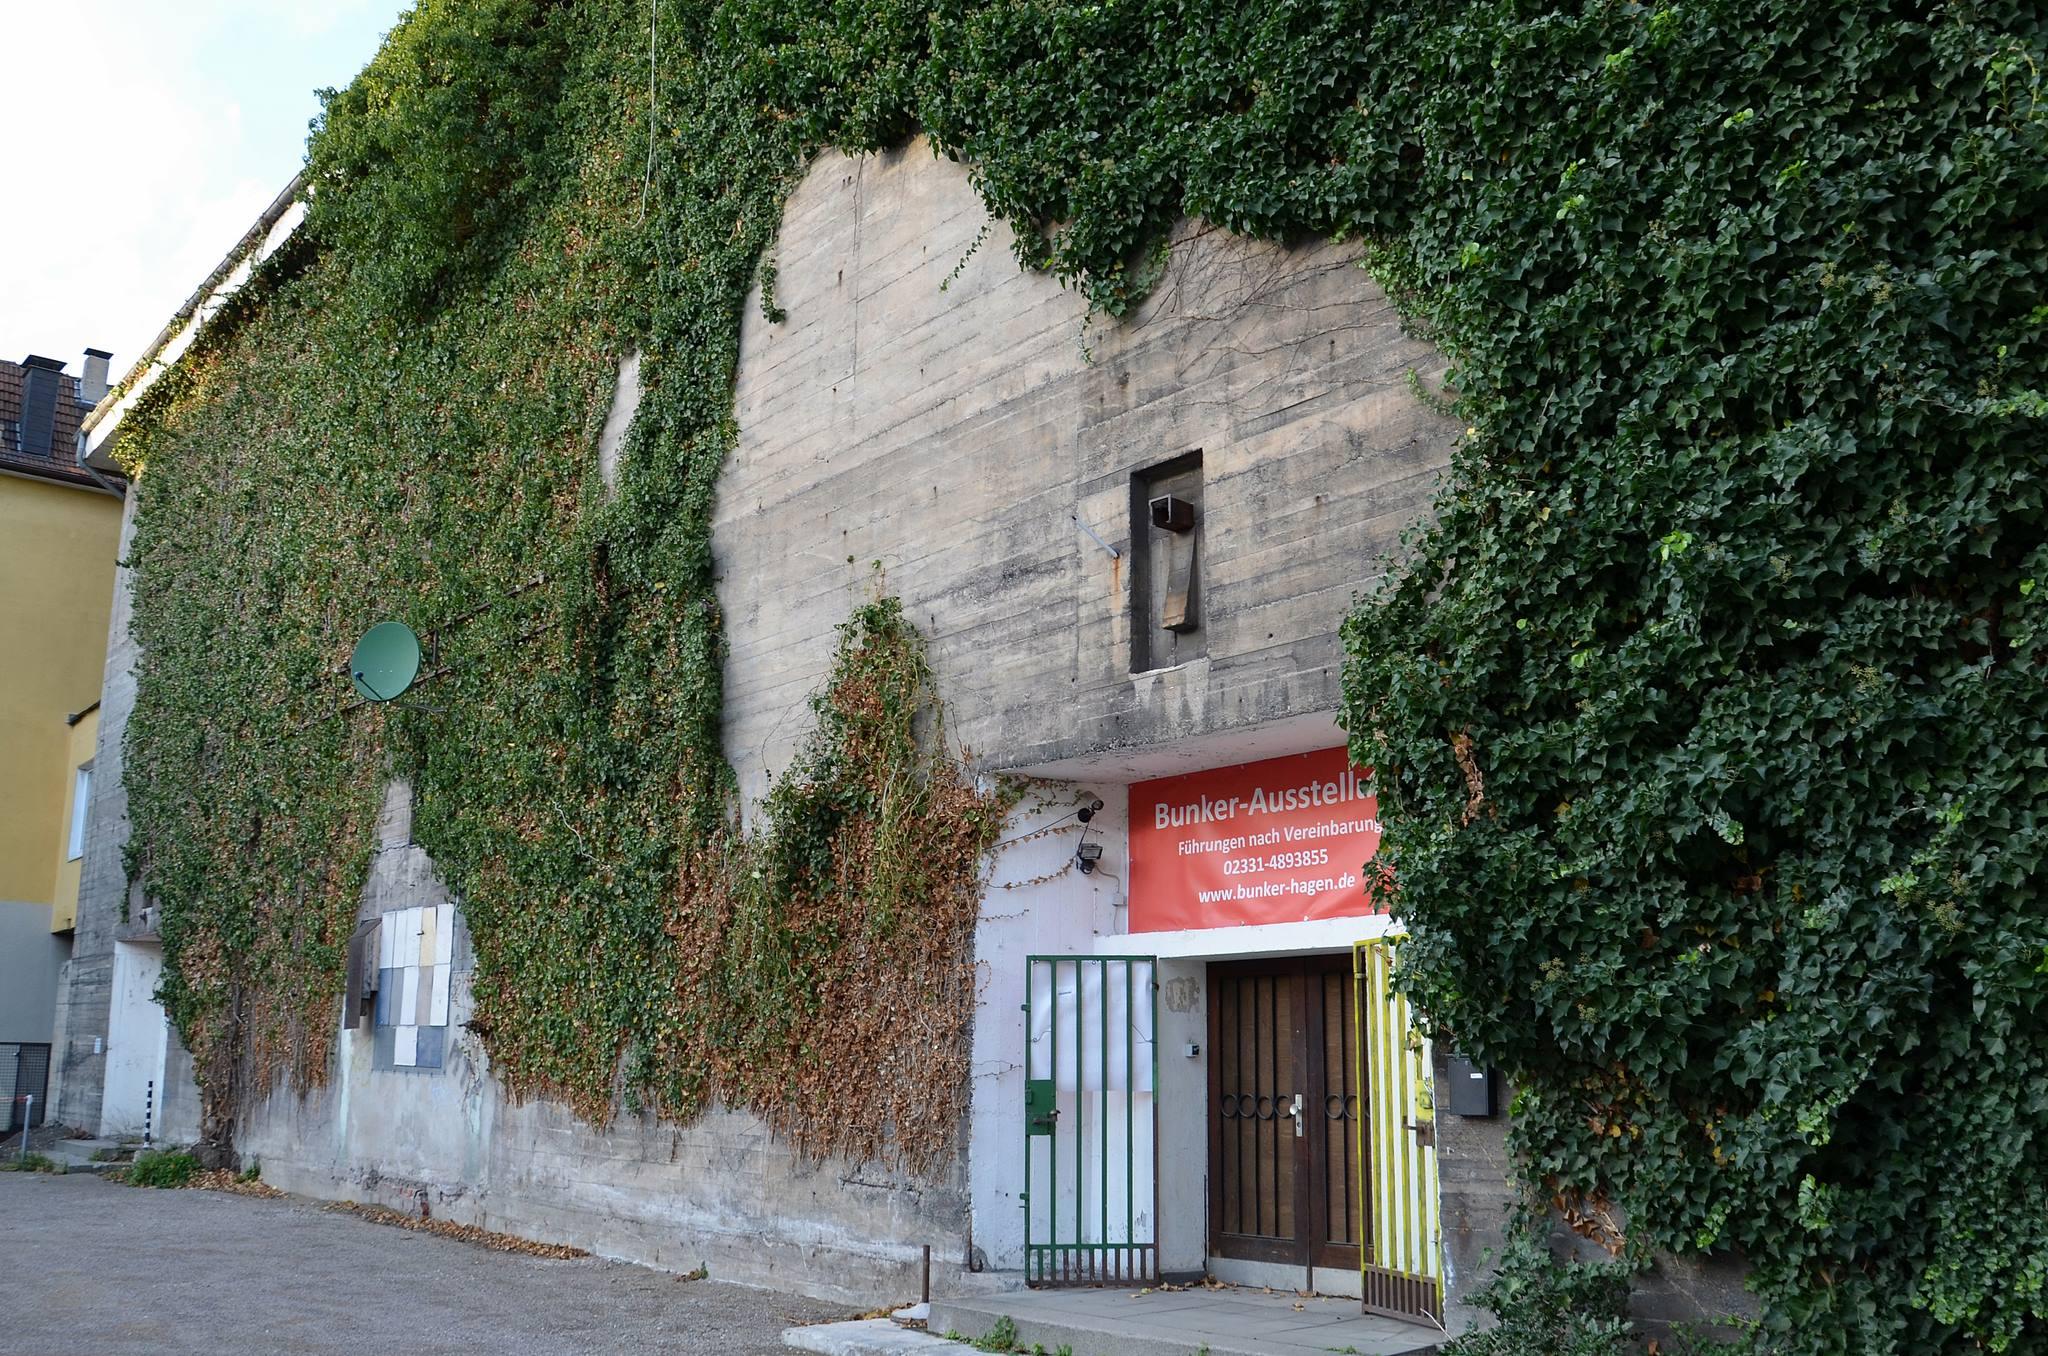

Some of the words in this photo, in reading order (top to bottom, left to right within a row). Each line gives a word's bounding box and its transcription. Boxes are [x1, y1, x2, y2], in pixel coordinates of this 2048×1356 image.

[1178, 836, 1246, 856] Führungen
[1249, 829, 1280, 849] nach
[1284, 818, 1383, 842] Vereinbarung
[1223, 848, 1329, 875] 02331-4893855
[1198, 872, 1355, 903] www.bunker-hagen.de
